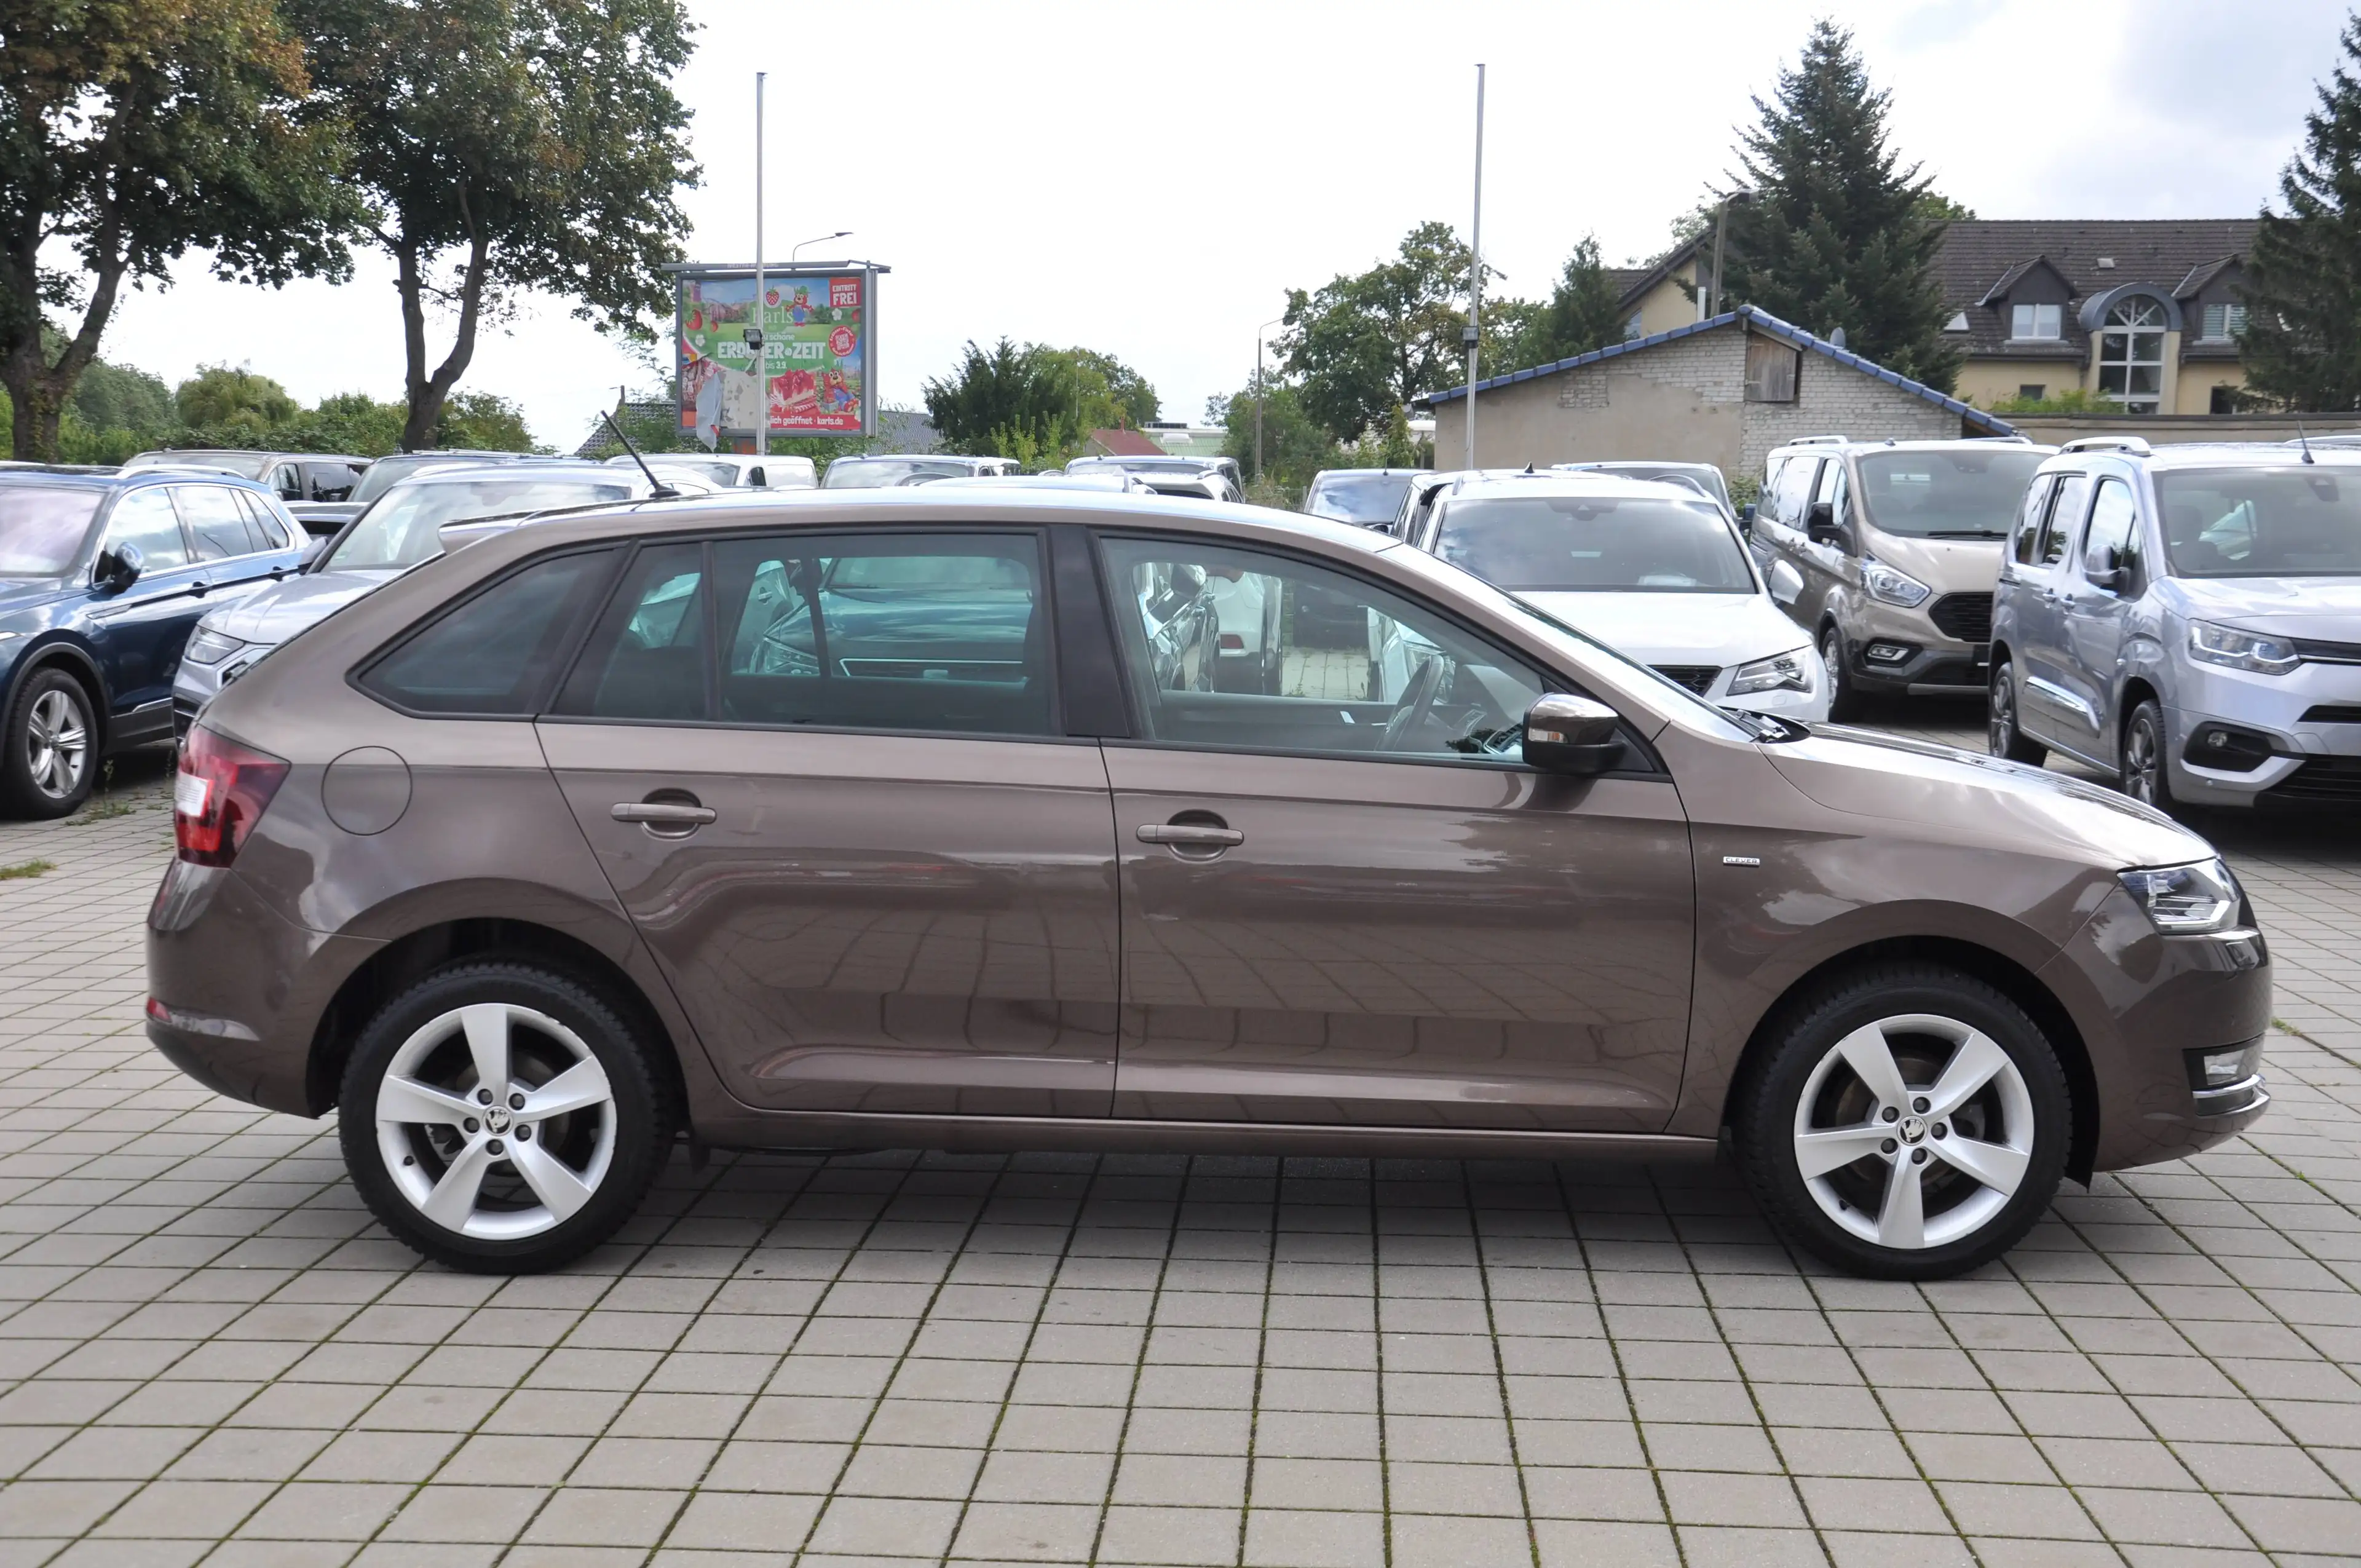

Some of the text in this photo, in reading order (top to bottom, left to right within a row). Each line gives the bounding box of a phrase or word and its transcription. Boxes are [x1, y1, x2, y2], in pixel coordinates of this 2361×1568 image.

[833, 291, 856, 305] FREI
[769, 332, 796, 341] schöne
[792, 341, 826, 359] ZEIT
[783, 416, 813, 426] geöffnet
[817, 416, 844, 426] karls.de
